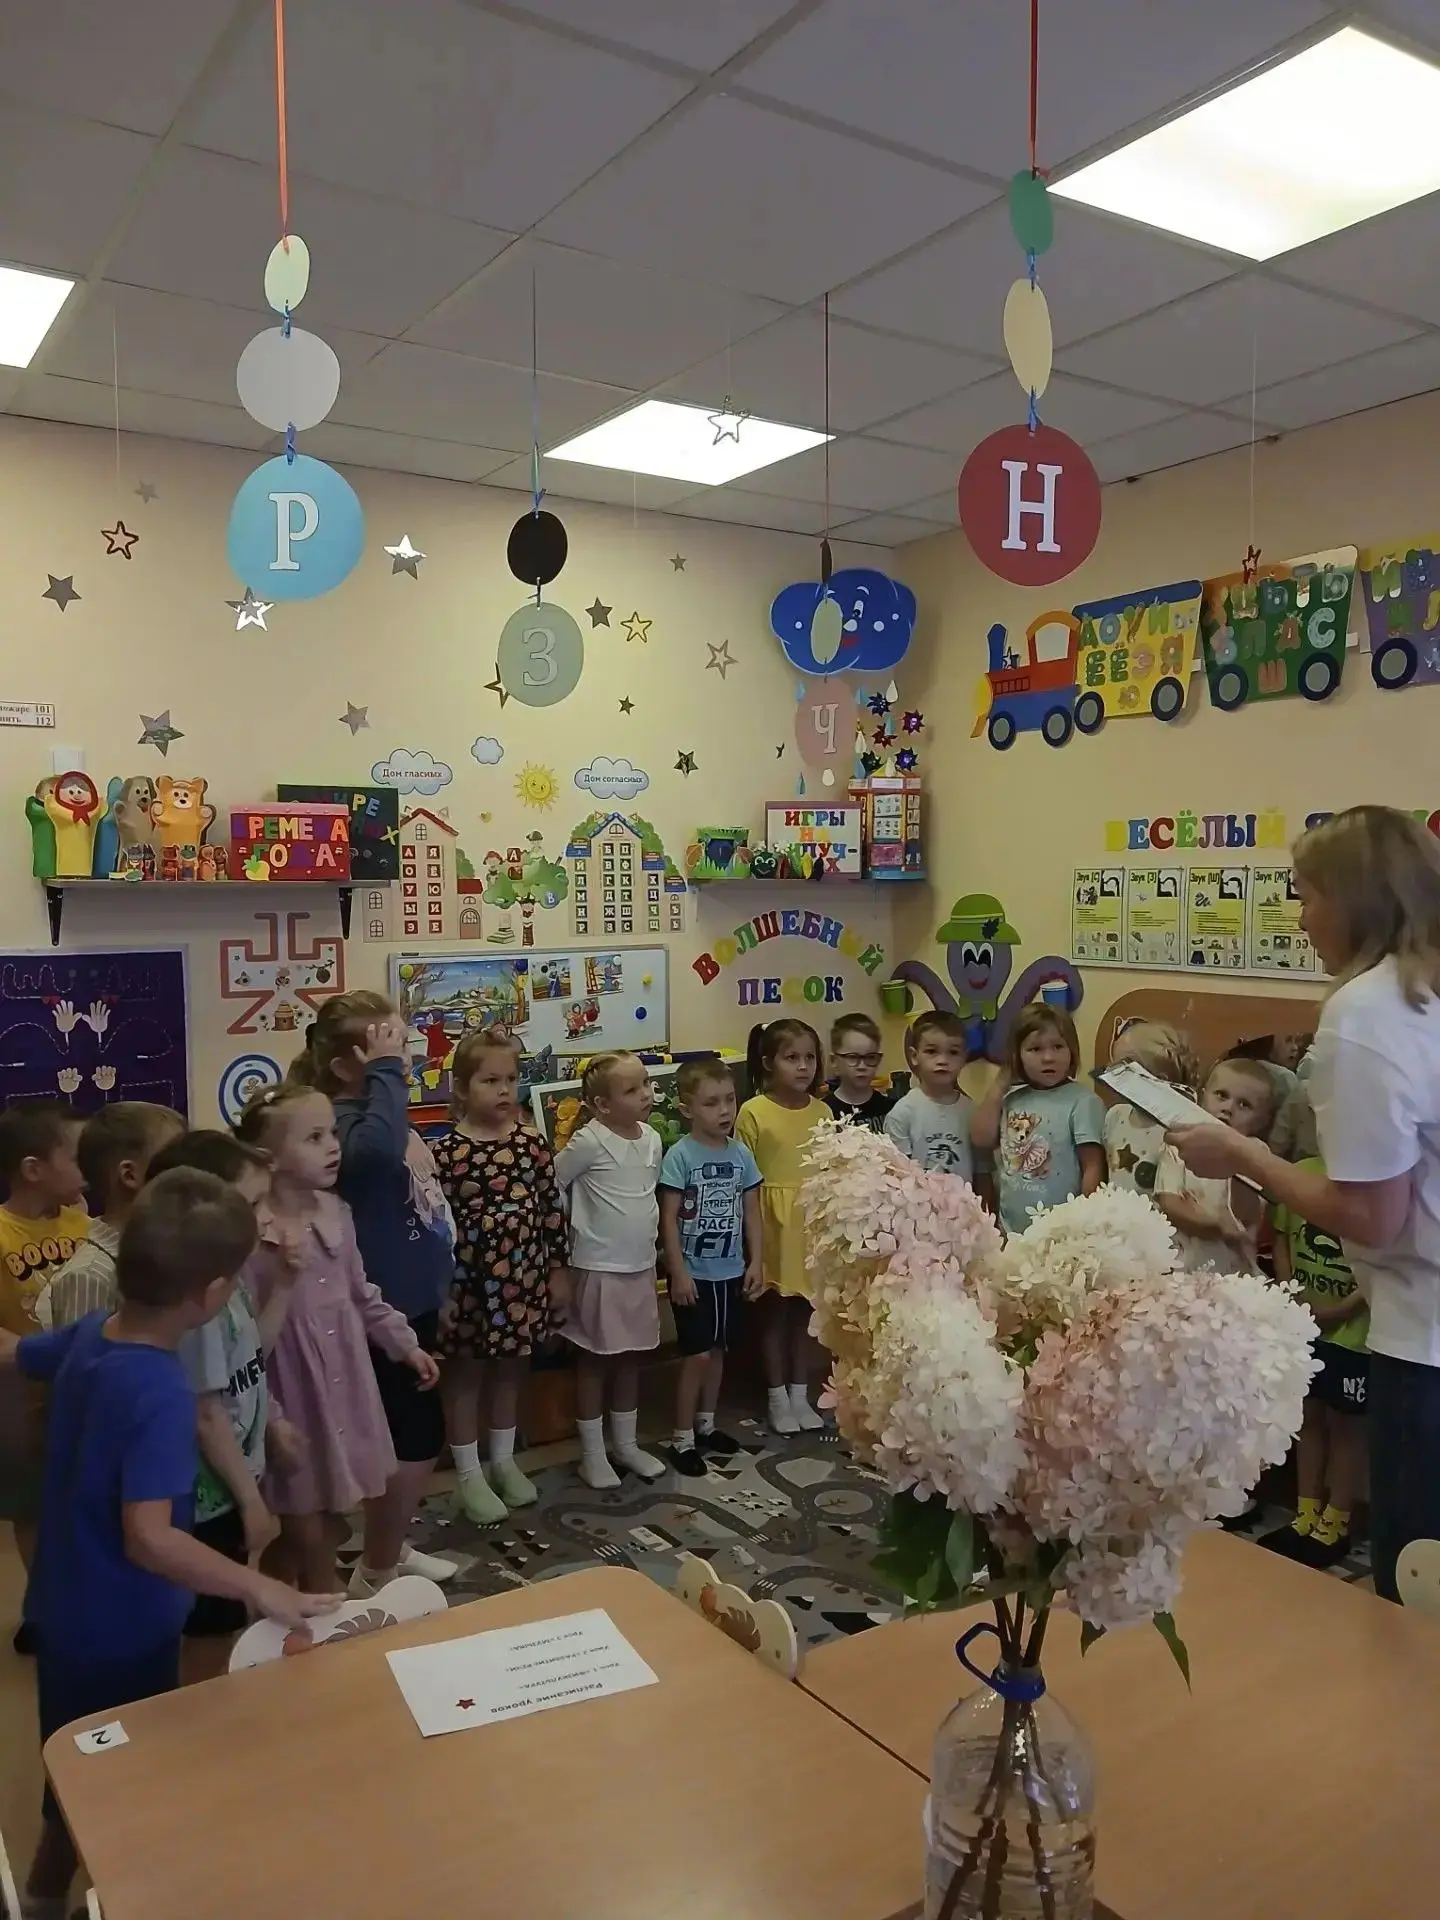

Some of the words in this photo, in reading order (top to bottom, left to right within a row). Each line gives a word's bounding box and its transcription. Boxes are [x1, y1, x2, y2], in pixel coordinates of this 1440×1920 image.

[1001, 460, 1063, 554] Н
[268, 492, 320, 571] Р
[36, 706, 50, 714] 101
[36, 716, 51, 726] 112
[382, 768, 402, 778] Дом
[404, 770, 442, 778] гласных
[584, 774, 600, 783] Дом
[784, 810, 846, 827] ИГРЫ
[1190, 872, 1206, 885] Звук
[1255, 871, 1272, 884] Звук
[698, 1218, 734, 1230] RACE
[694, 1231, 733, 1258] F1
[5, 1236, 87, 1281] BOOB
[536, 1682, 604, 1704] Расписание
[490, 1700, 533, 1714] уроков
[92, 1730, 112, 1746] 2
